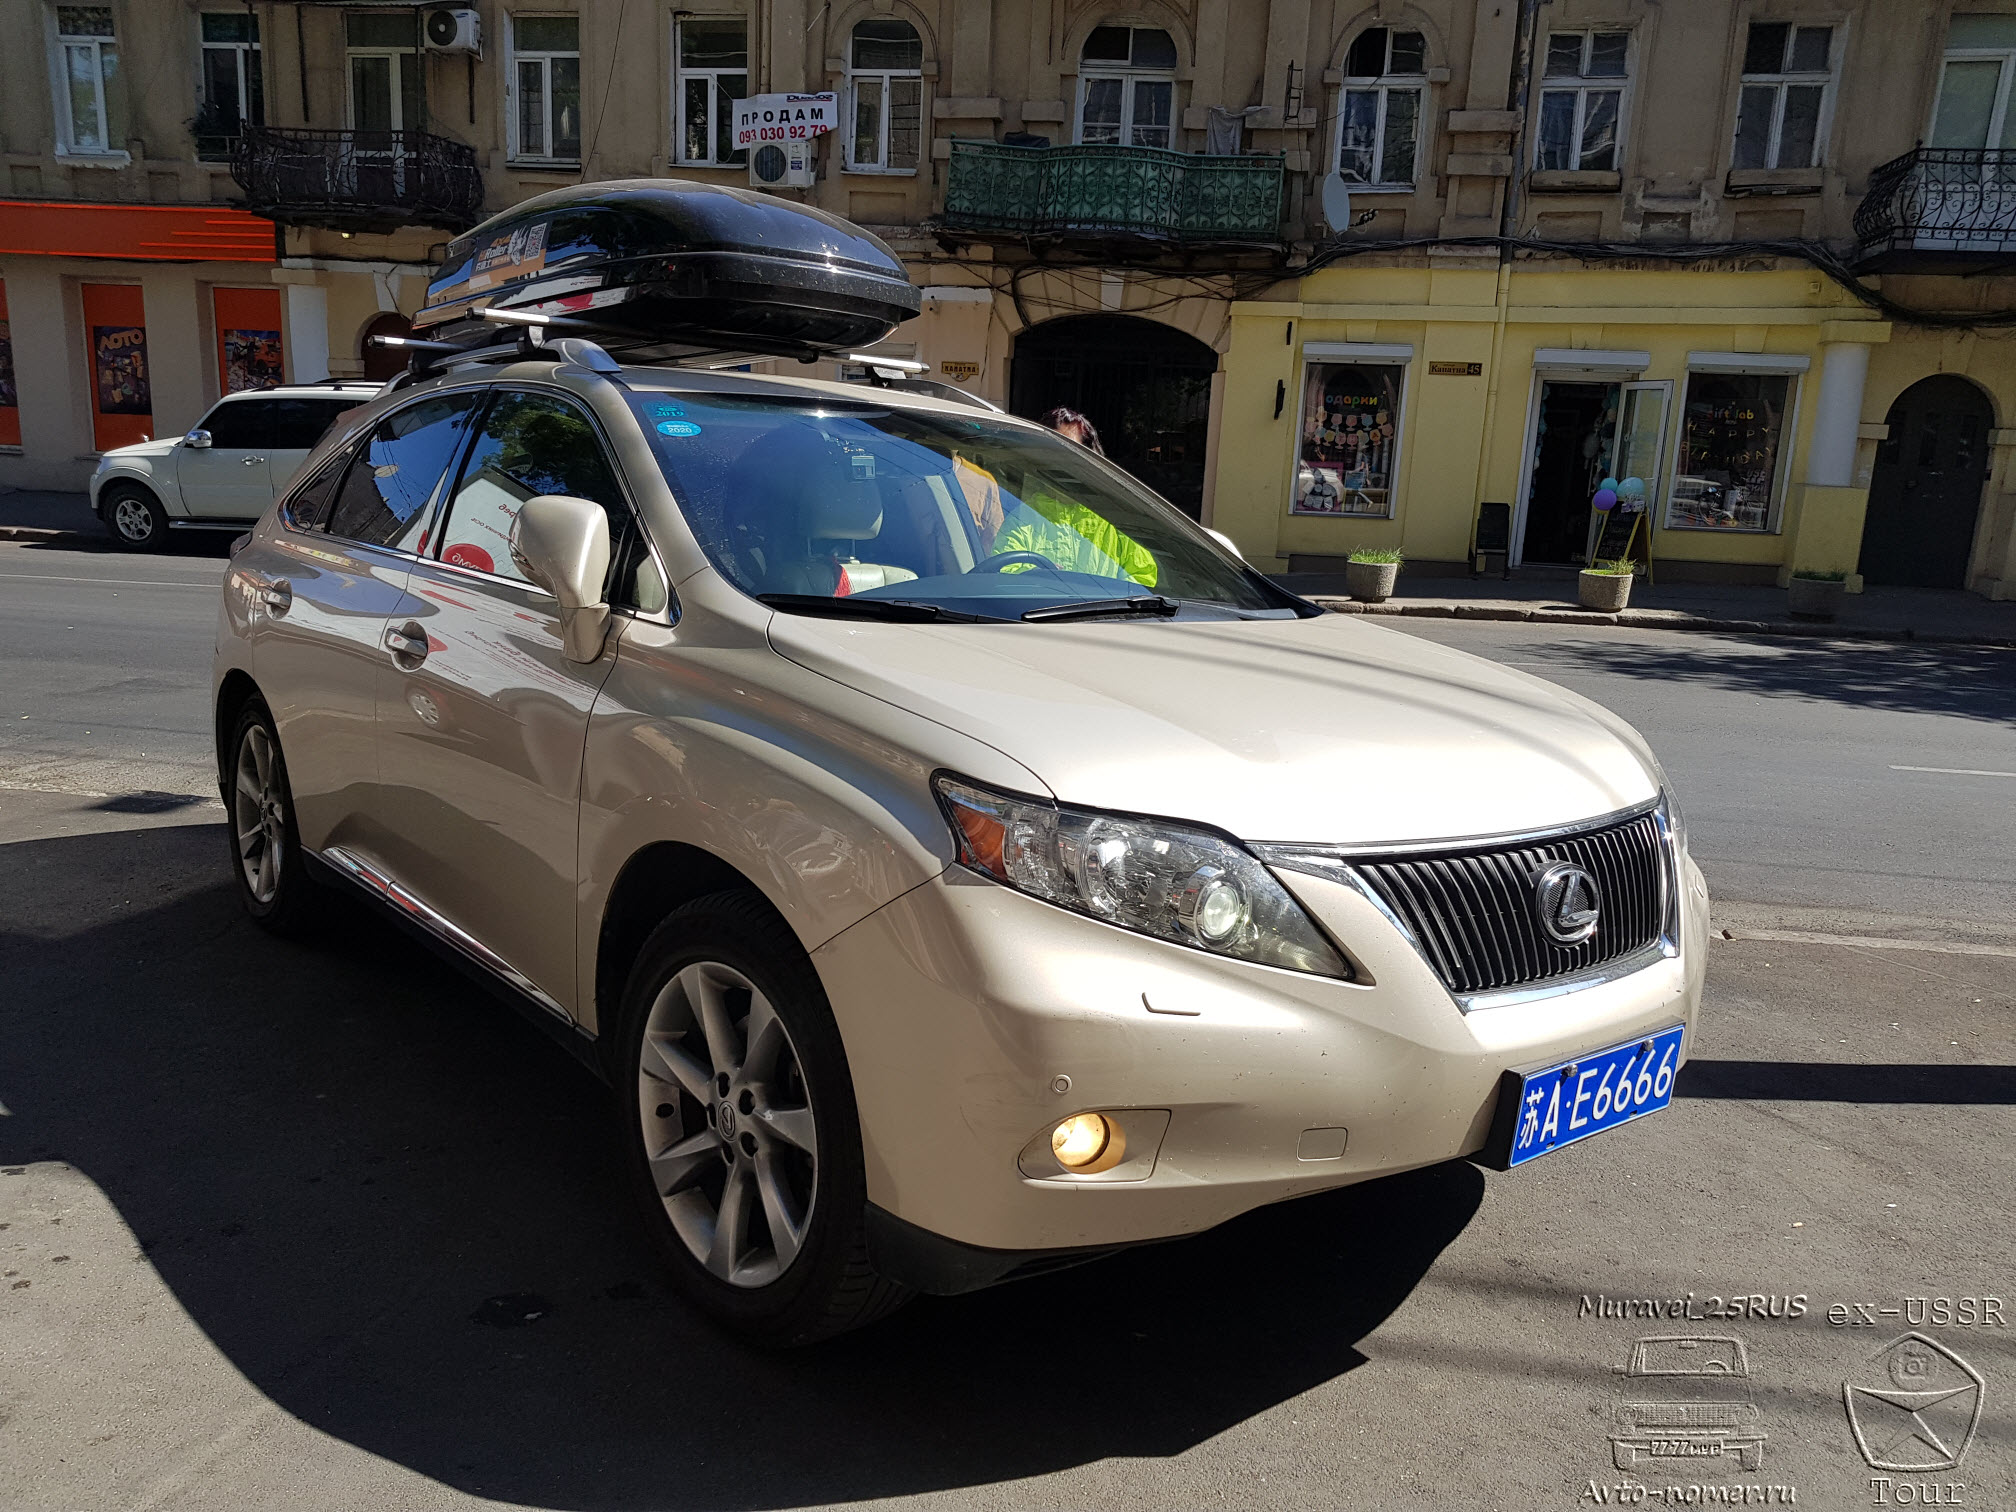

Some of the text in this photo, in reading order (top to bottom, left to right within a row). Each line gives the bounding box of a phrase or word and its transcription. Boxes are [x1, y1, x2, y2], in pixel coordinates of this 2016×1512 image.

[741, 108, 823, 125] ПРОДАМ
[739, 129, 757, 143] 093
[760, 127, 785, 140] 030
[789, 126, 806, 139] 92
[100, 328, 144, 350] ЛОТО
[1468, 364, 1480, 374] 45
[1325, 394, 1378, 408] одарки
[1518, 1043, 1675, 1150] 苏A·E6666
